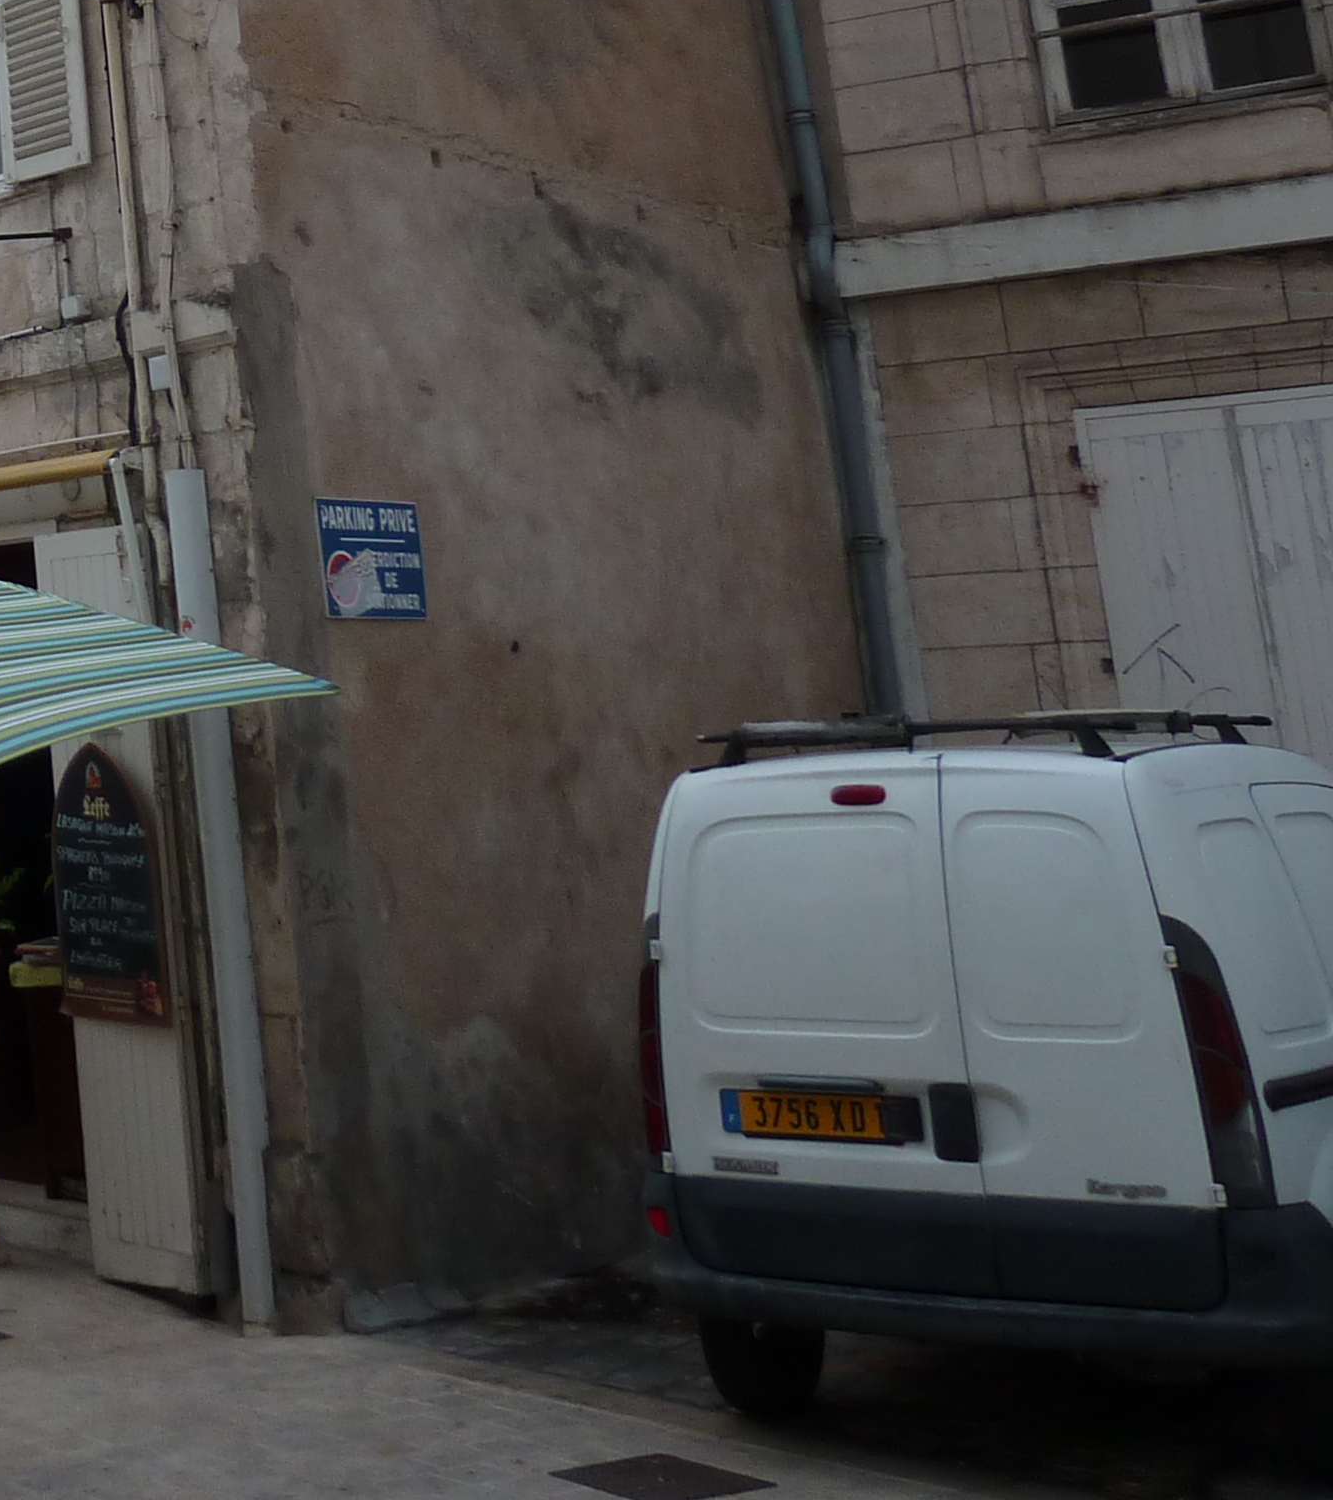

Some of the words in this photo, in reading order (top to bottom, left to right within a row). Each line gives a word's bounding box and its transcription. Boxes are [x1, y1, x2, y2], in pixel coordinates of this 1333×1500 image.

[320, 505, 375, 531] PARKING
[378, 507, 416, 533] PRIVE
[356, 551, 421, 569] ERDICTION
[384, 572, 399, 589] DE
[82, 795, 111, 820] Leffe
[752, 1096, 820, 1131] 3756
[832, 1100, 866, 1133] XD
